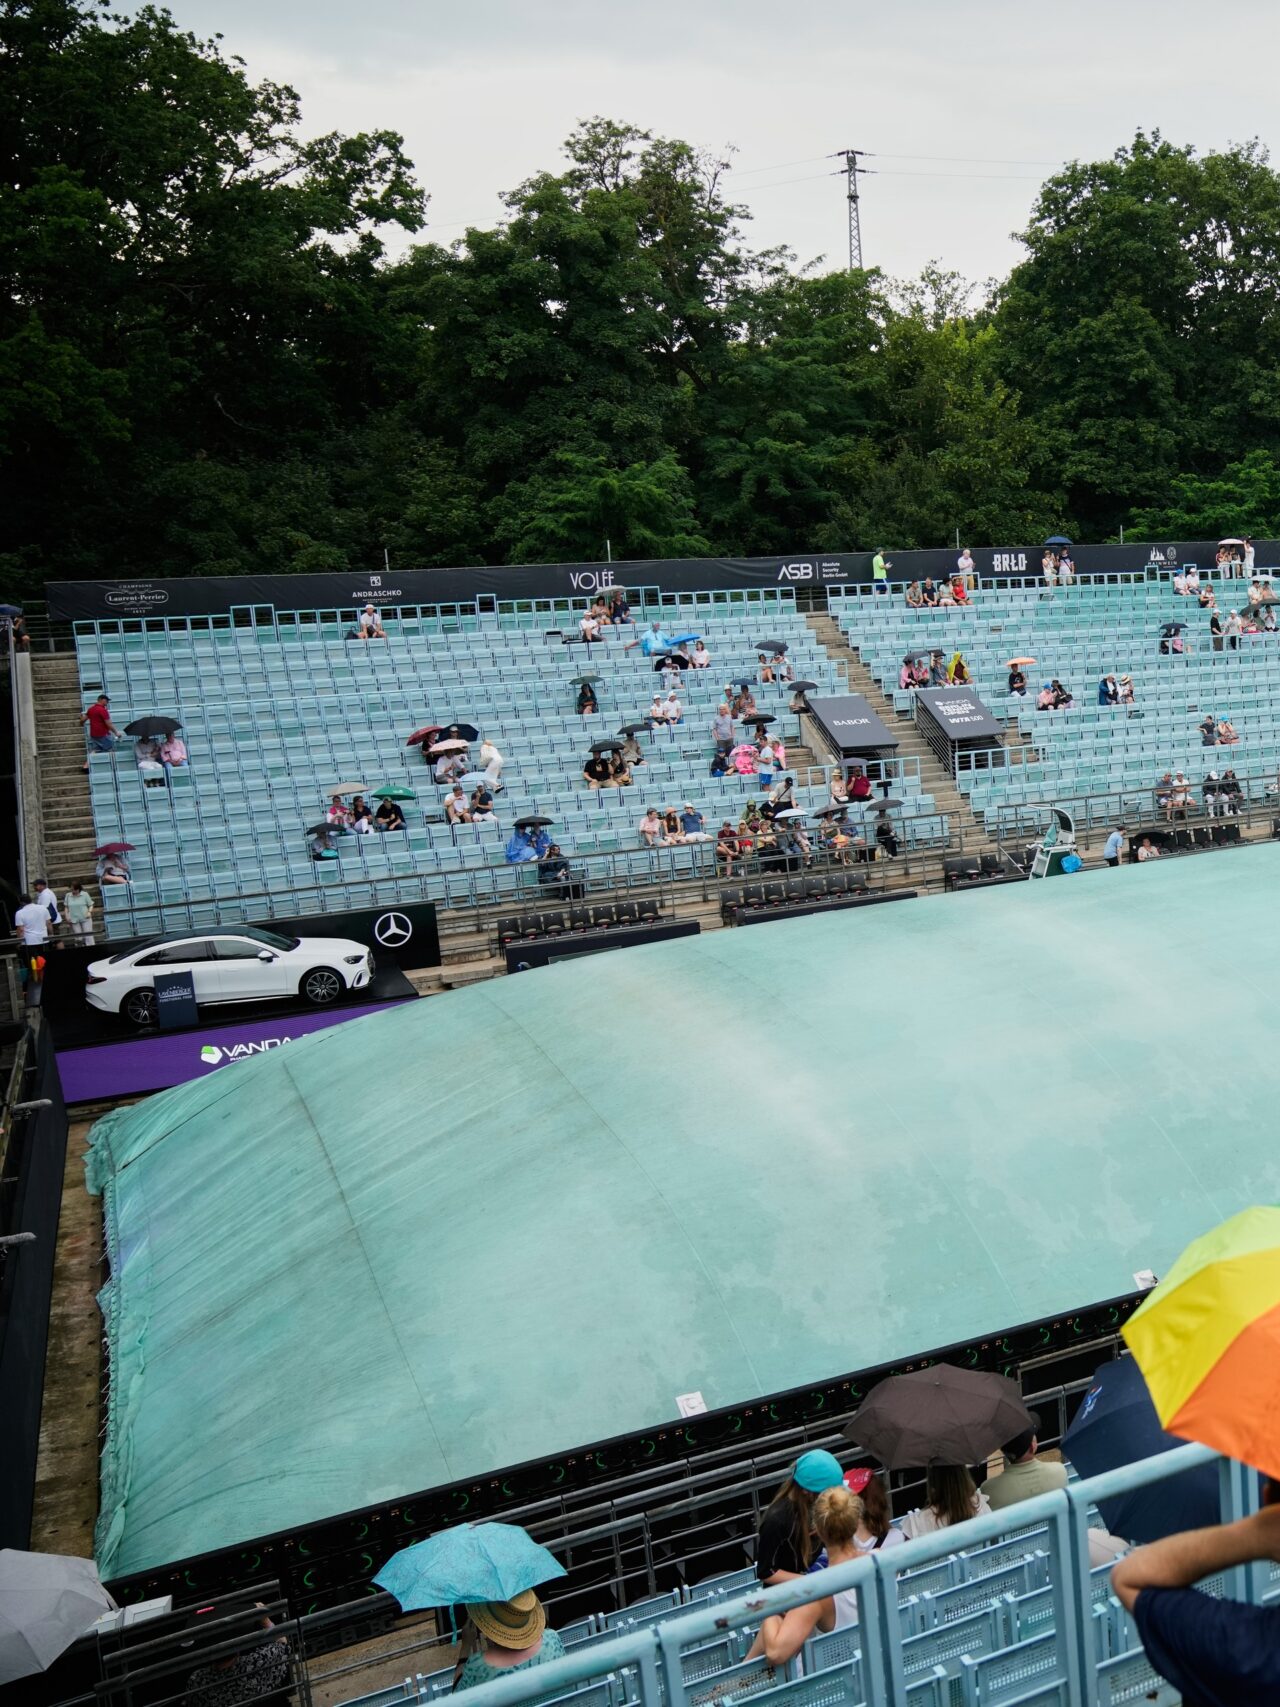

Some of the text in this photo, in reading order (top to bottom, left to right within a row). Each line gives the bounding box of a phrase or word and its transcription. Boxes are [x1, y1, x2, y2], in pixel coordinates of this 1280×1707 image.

[108, 593, 166, 602] Laurent-Perrier
[352, 590, 402, 598] ANDRASCHKO
[832, 718, 871, 726] BABOR
